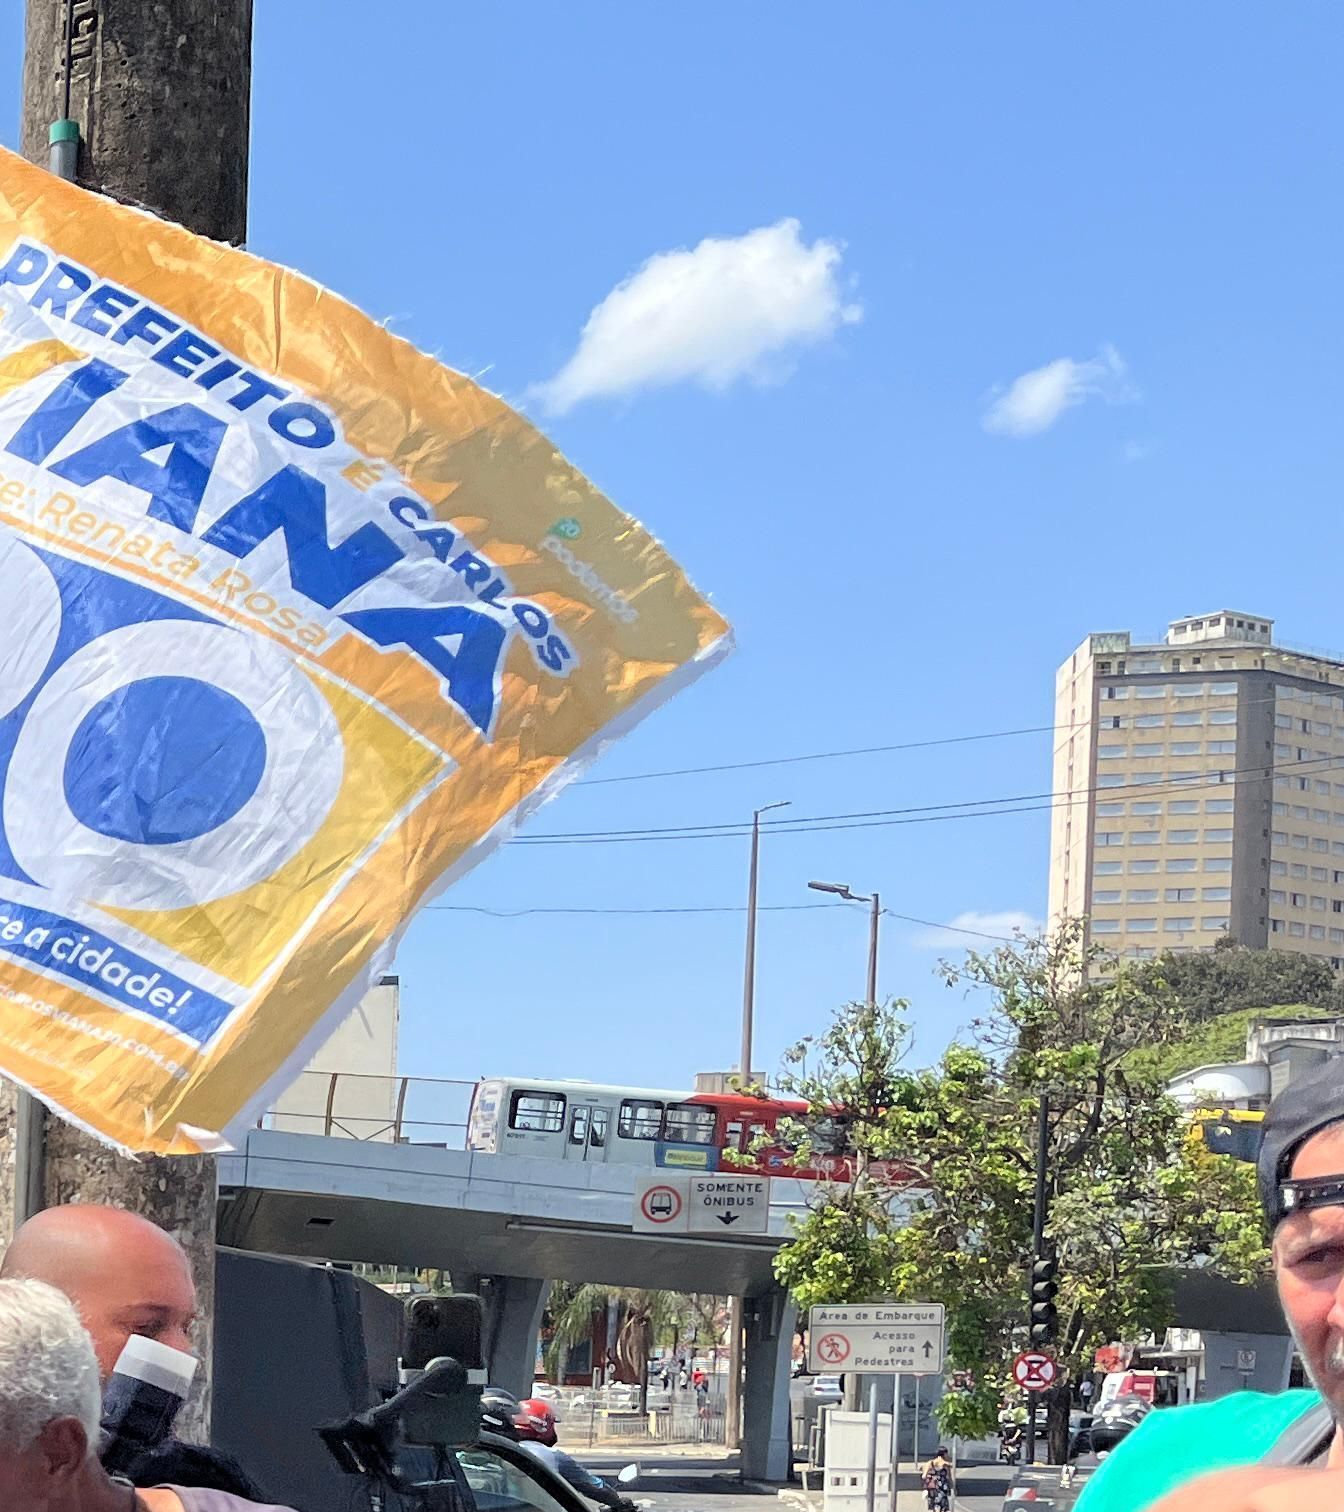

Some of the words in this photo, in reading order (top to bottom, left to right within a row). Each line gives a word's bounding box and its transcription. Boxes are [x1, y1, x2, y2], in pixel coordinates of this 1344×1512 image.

[39, 492, 199, 578] Renata
[210, 568, 330, 647] Rosa
[389, 496, 570, 671] CARLOS
[23, 927, 50, 950] a
[50, 936, 193, 1014] cidade!
[697, 1183, 763, 1194] SOMENTE
[855, 1311, 869, 1320] de
[875, 1311, 936, 1321] Embarque
[872, 1331, 916, 1340] Acesso
[889, 1344, 915, 1354] para
[855, 1357, 914, 1366] Pedestres
